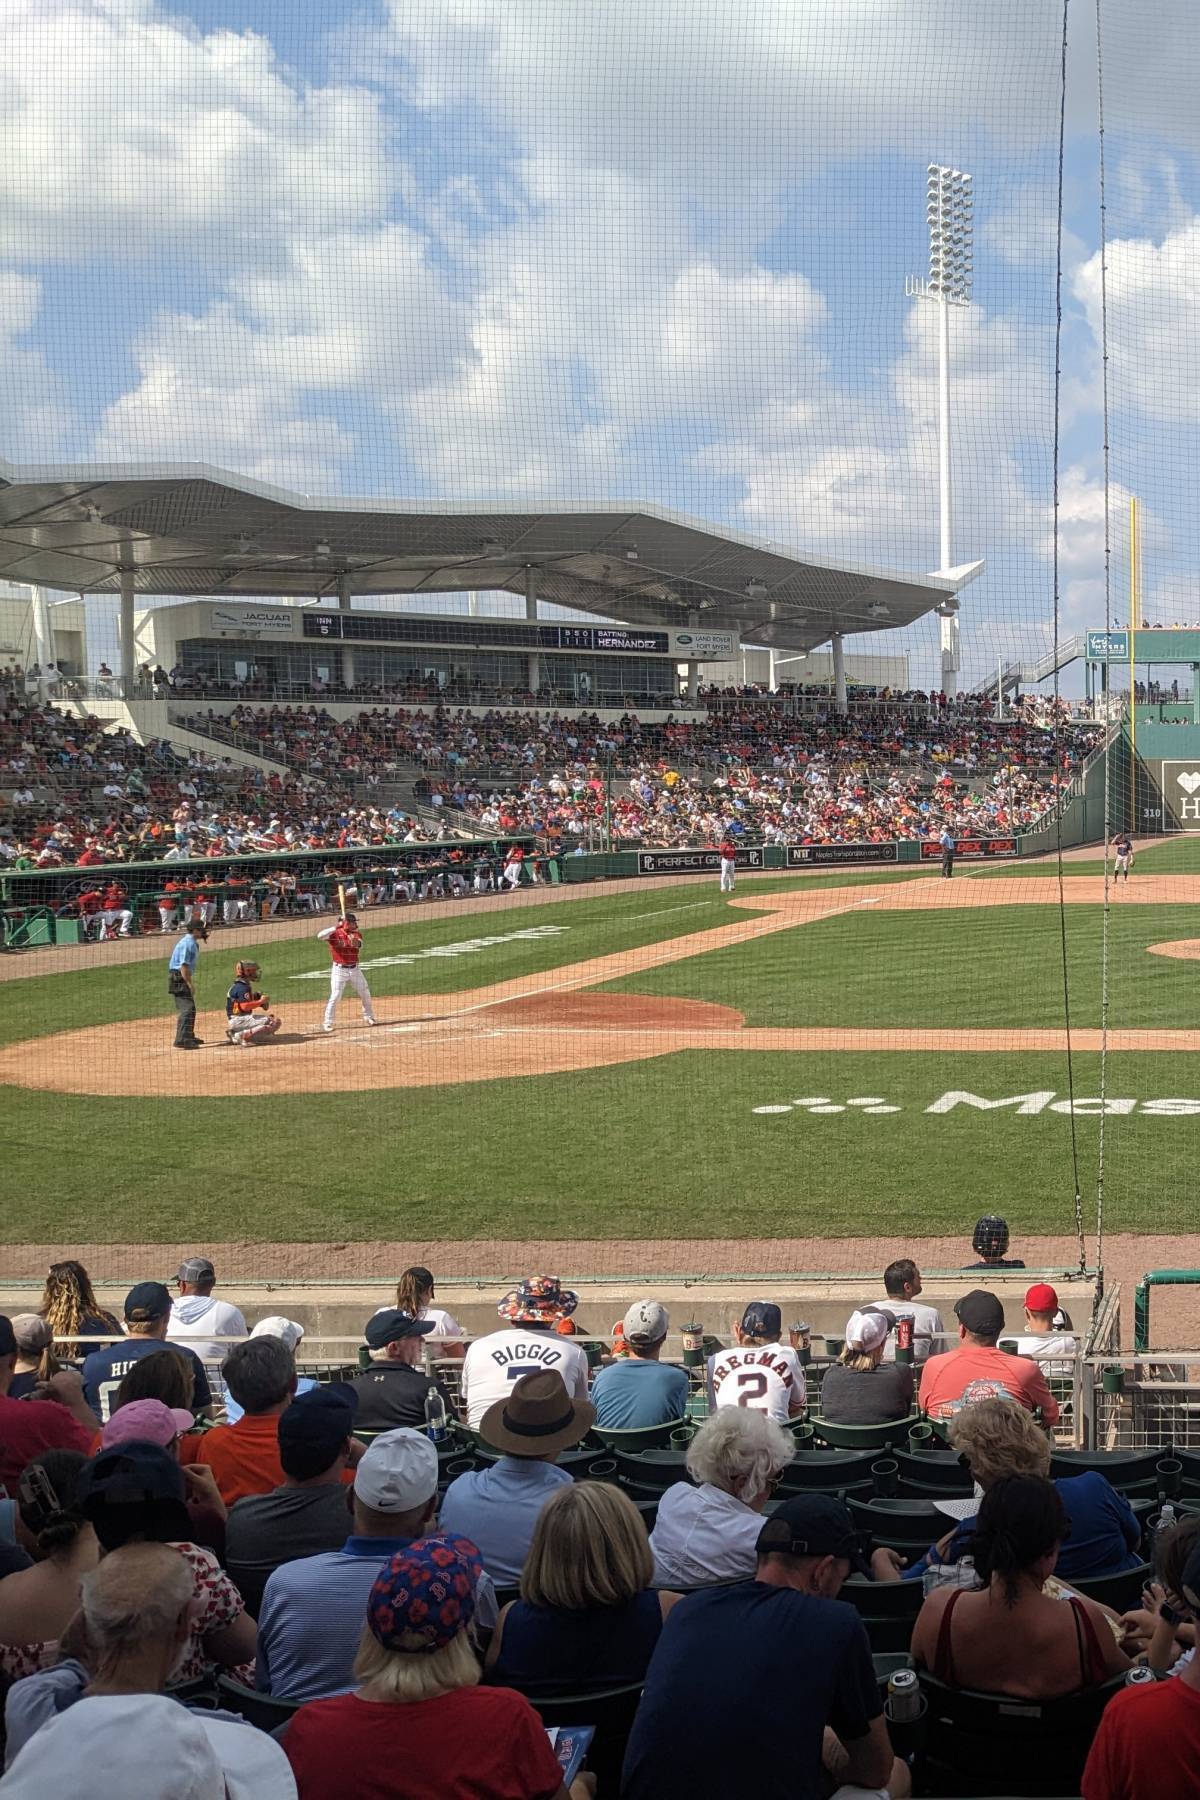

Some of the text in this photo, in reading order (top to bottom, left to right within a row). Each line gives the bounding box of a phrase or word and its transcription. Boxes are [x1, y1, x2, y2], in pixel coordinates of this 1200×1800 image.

[243, 613, 290, 622] JAGUAR
[316, 617, 332, 625] INN
[320, 626, 329, 634] 5
[598, 639, 657, 649] HERNANDEZ
[1144, 808, 1161, 818] 310
[657, 855, 704, 867] PERFECT
[491, 1344, 562, 1366] BIGGIO
[738, 1373, 768, 1413] 2
